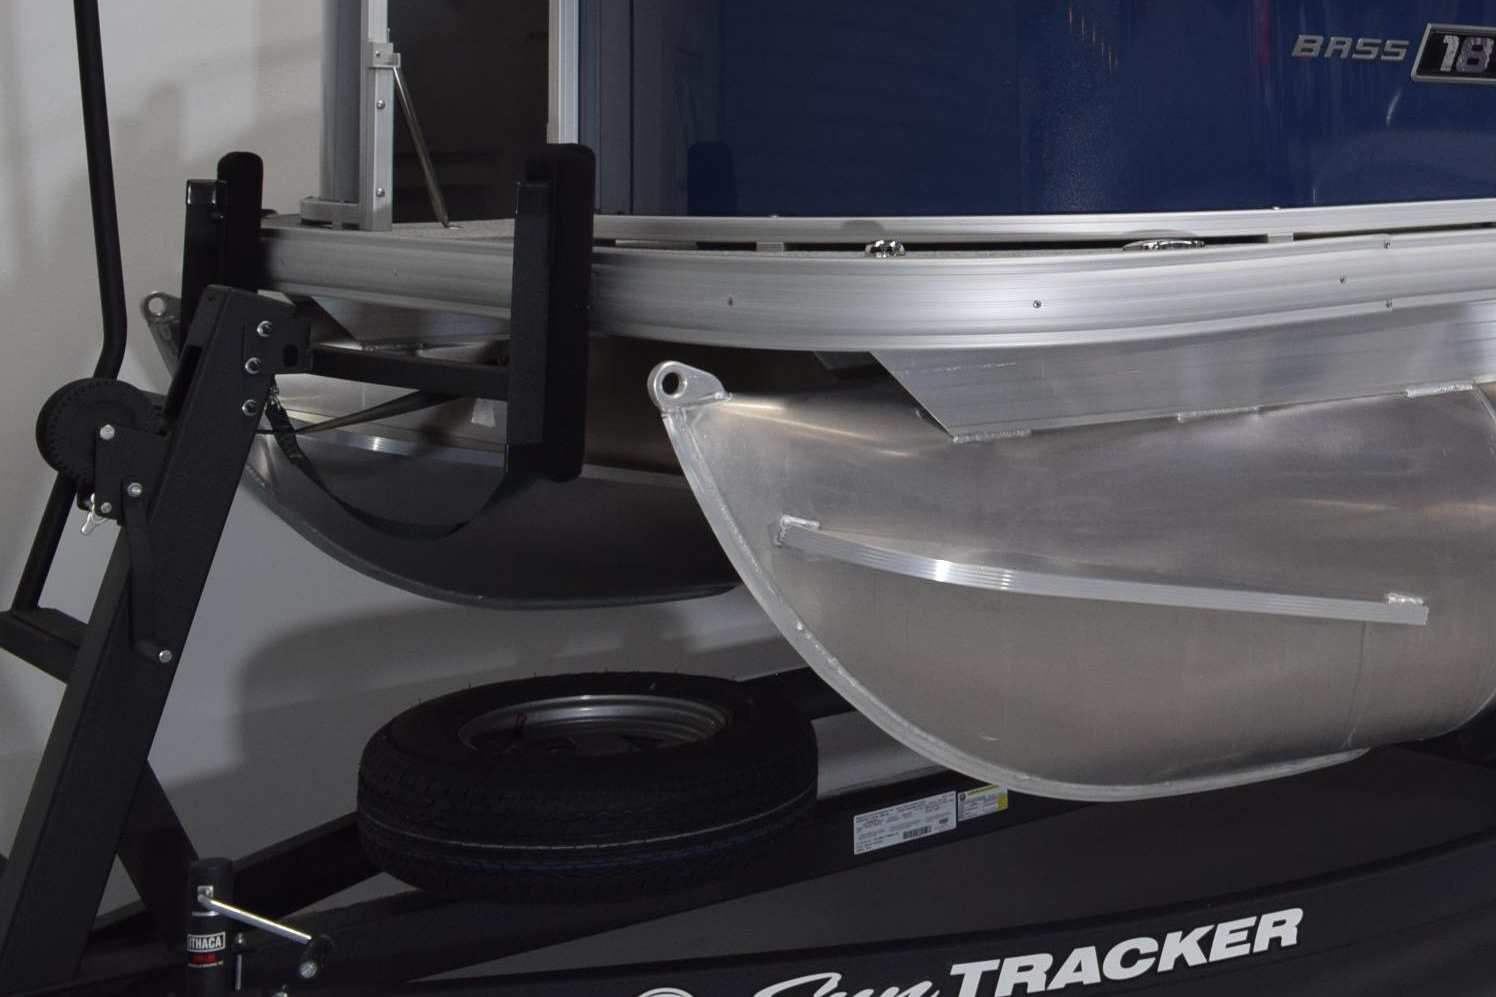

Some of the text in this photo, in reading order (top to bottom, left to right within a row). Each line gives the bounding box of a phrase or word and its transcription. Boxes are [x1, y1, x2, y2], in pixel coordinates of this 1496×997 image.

[1291, 34, 1409, 61] BASS
[1439, 34, 1495, 74] 18
[189, 936, 222, 950] ITHACA
[950, 907, 1304, 997] TRACKER
